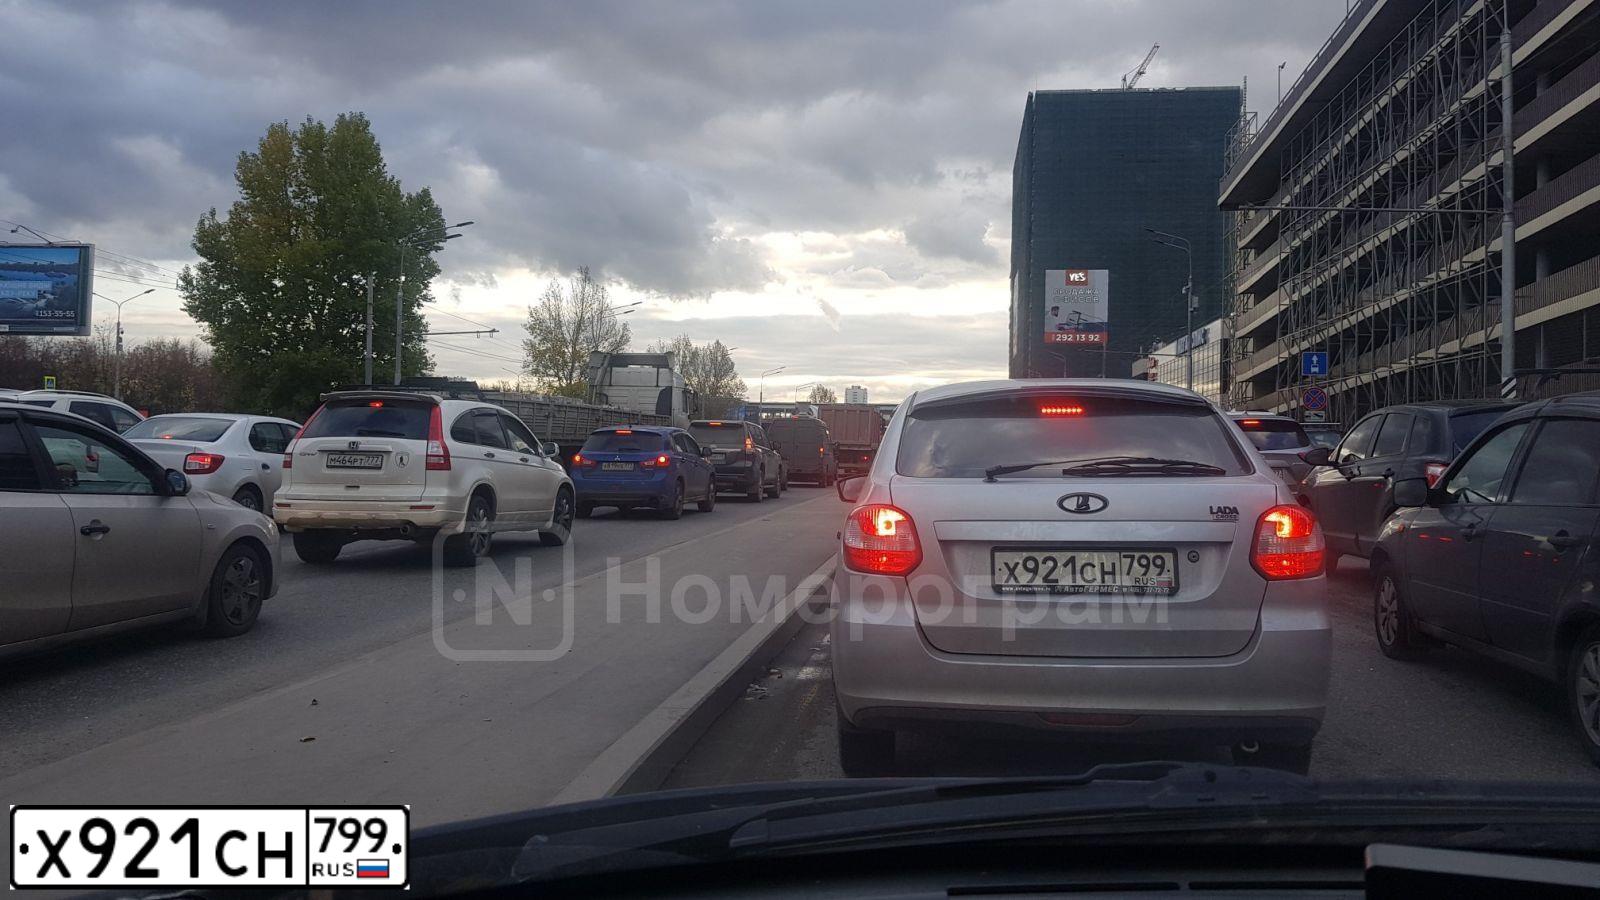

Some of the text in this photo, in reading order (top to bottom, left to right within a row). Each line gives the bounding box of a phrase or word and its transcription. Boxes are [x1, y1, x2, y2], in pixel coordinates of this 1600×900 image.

[1069, 273, 1086, 281] YES
[1055, 334, 1100, 342] 292 13 92
[1209, 505, 1239, 515] LADA
[1003, 554, 1166, 584] Х921СН 799
[1134, 577, 1156, 586] RUS
